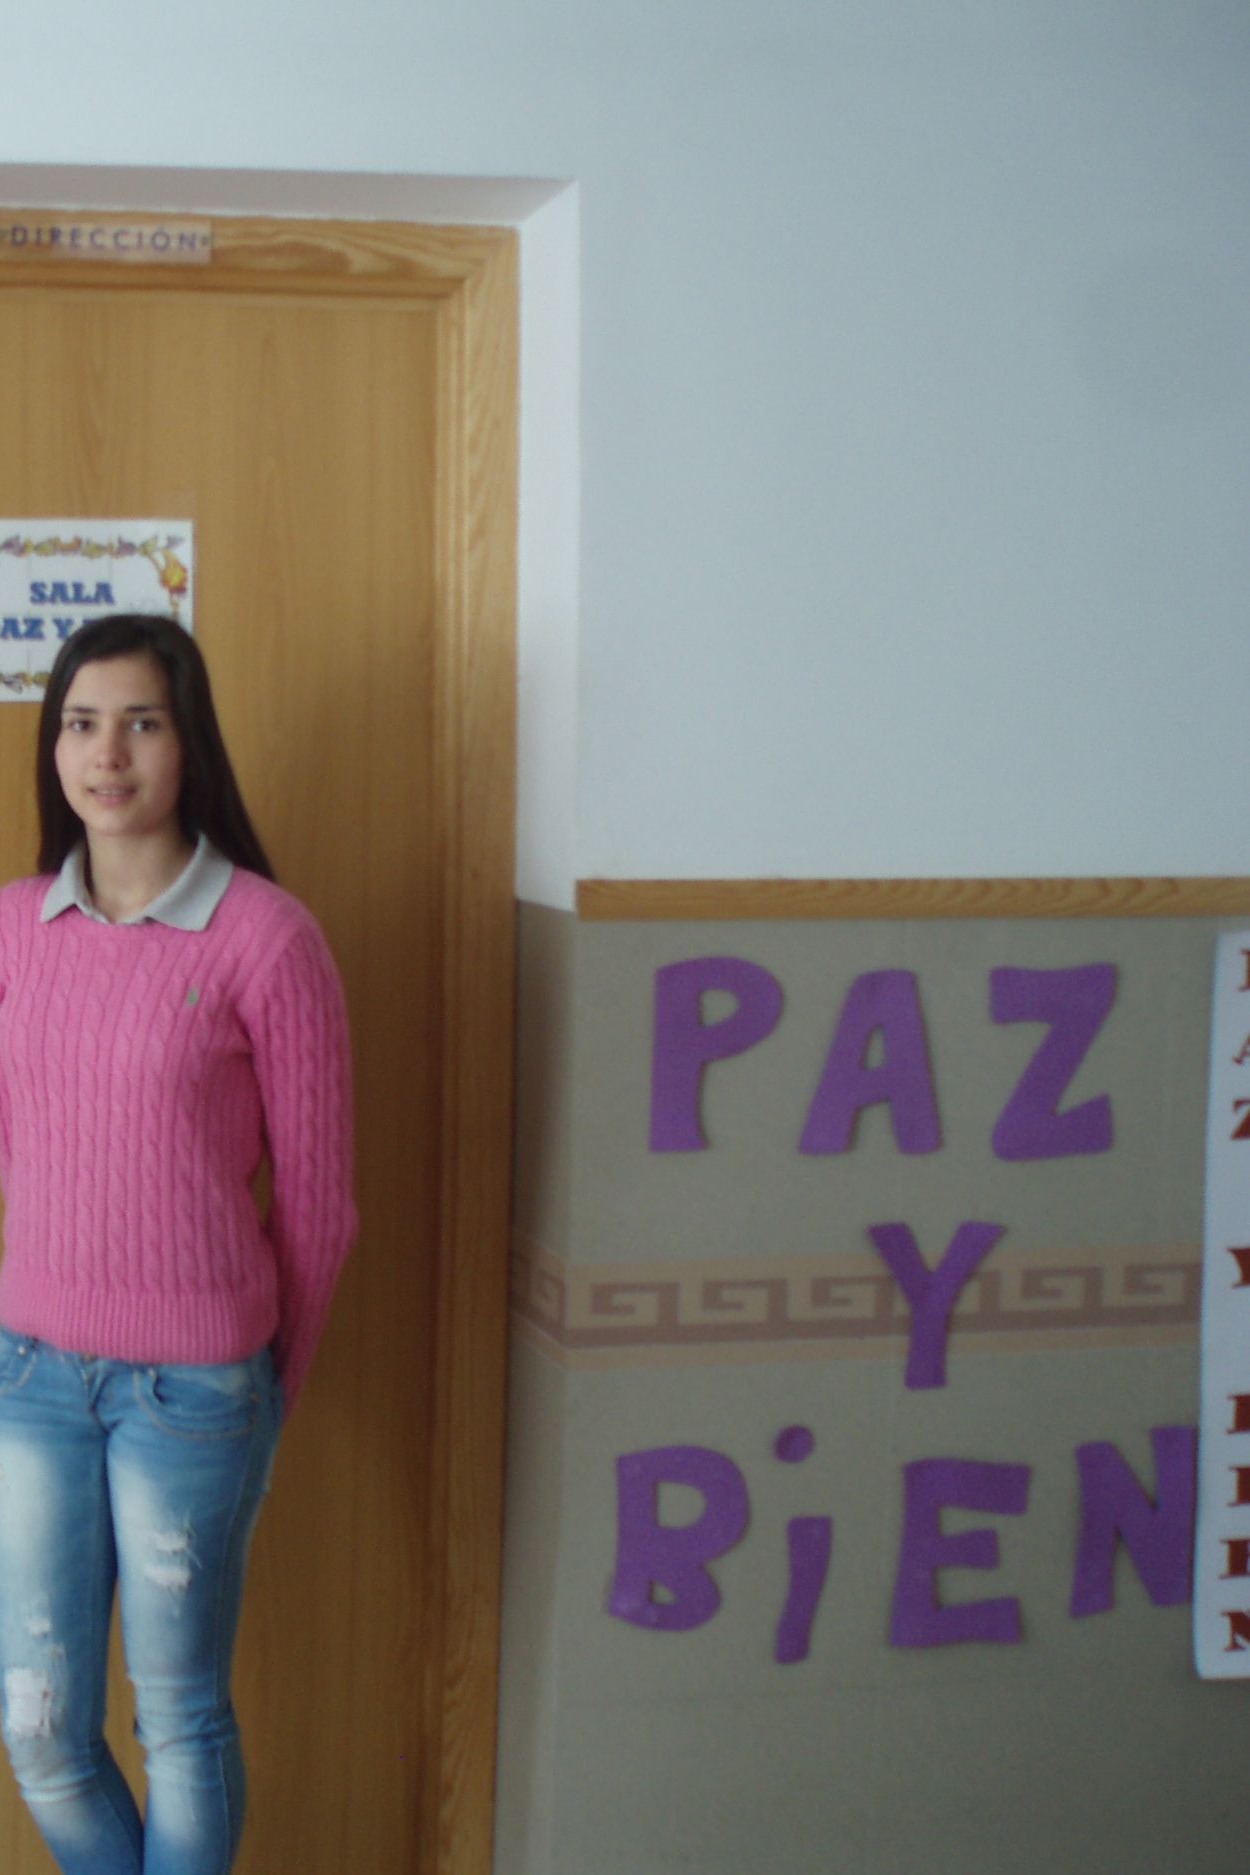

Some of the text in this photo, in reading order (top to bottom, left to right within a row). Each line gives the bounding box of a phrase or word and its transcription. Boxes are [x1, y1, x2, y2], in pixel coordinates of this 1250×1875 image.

[29, 581, 116, 605] SALA
[52, 616, 75, 641] Y
[648, 955, 1119, 1162] PAZ
[866, 1221, 1007, 1390] Y
